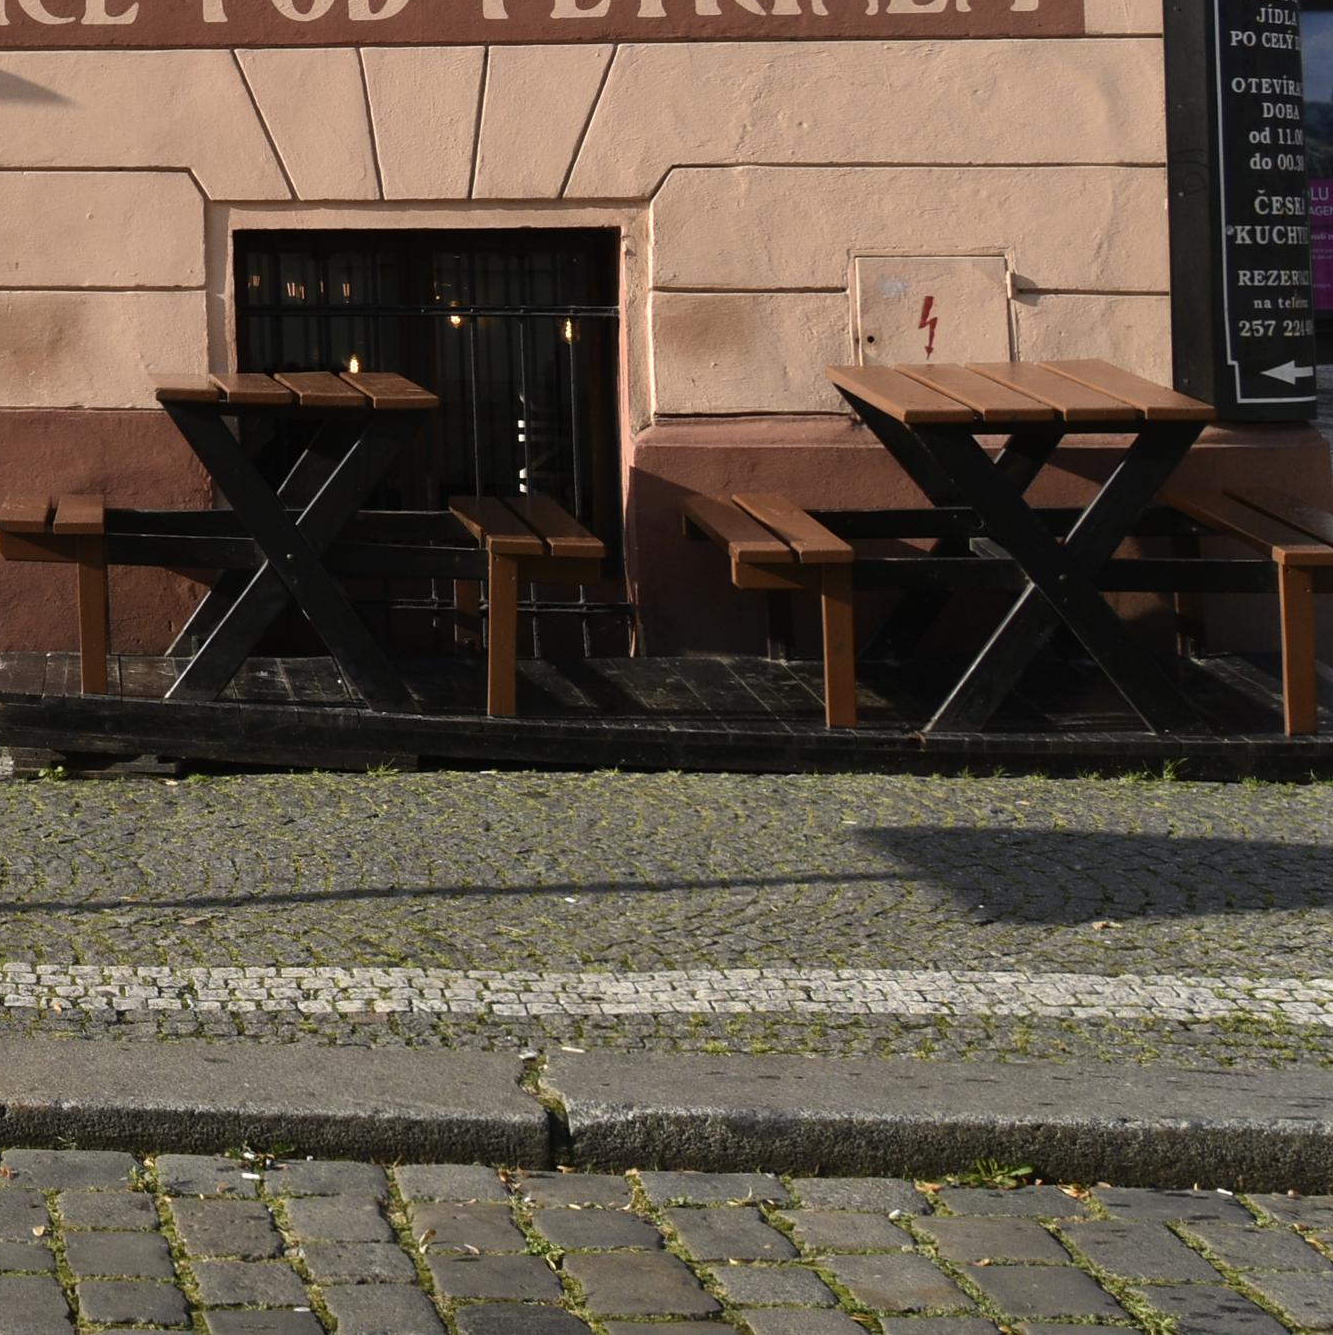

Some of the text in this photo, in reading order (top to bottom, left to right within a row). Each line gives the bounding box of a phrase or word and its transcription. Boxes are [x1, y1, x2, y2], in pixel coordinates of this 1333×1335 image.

[1256, 3, 1298, 27] JÍDLA
[1229, 30, 1257, 47] PO
[1231, 75, 1303, 97] OTEVÍRA
[1261, 101, 1300, 120] DOBA
[1248, 126, 1271, 144] od
[1249, 152, 1272, 170] do
[1306, 187, 1329, 201] LU
[1234, 221, 1309, 245] KUCHY
[1253, 297, 1272, 309] na
[1238, 319, 1277, 337] 257
